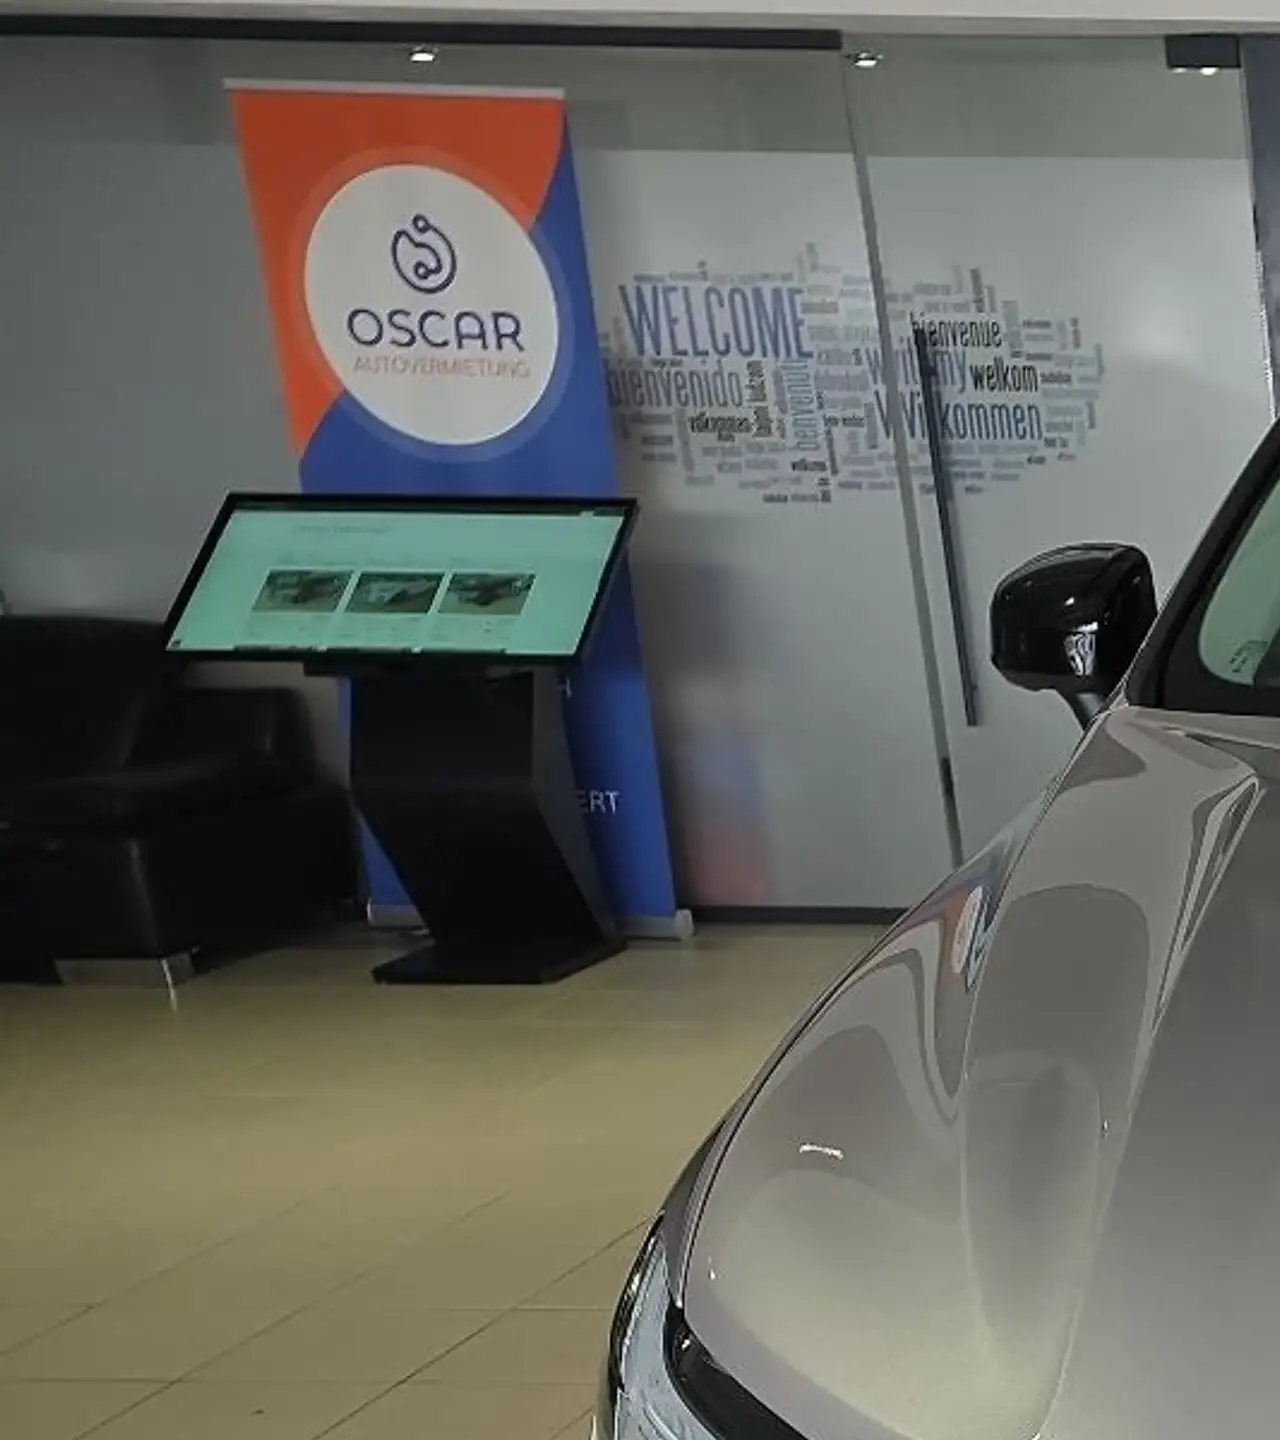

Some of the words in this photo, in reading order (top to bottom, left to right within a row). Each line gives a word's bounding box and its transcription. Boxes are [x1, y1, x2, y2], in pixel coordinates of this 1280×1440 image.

[347, 308, 525, 352] OSCAR
[618, 284, 814, 359] WELCOME
[603, 358, 744, 408] bienvenido
[865, 336, 967, 394] witmy
[969, 356, 1040, 393] welkom
[874, 389, 1043, 441] Wikommen
